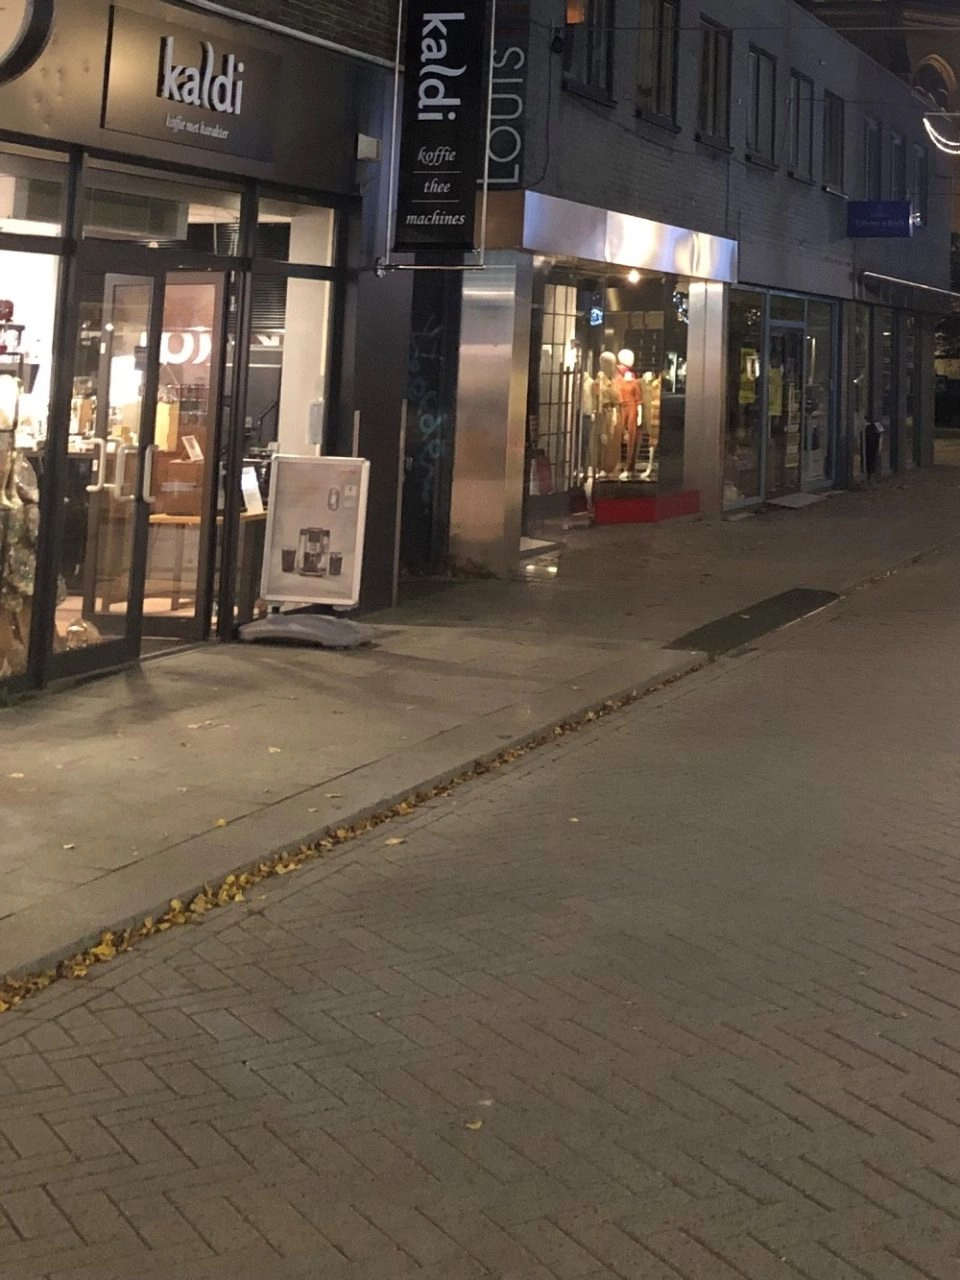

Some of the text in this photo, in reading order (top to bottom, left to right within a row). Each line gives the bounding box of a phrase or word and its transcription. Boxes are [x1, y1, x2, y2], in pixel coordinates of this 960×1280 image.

[163, 35, 245, 115] kaldi
[418, 12, 468, 120] kaldi
[477, 47, 525, 184] LOUIS
[417, 146, 456, 166] koffie
[423, 178, 451, 193] thee
[405, 210, 466, 225] machines
